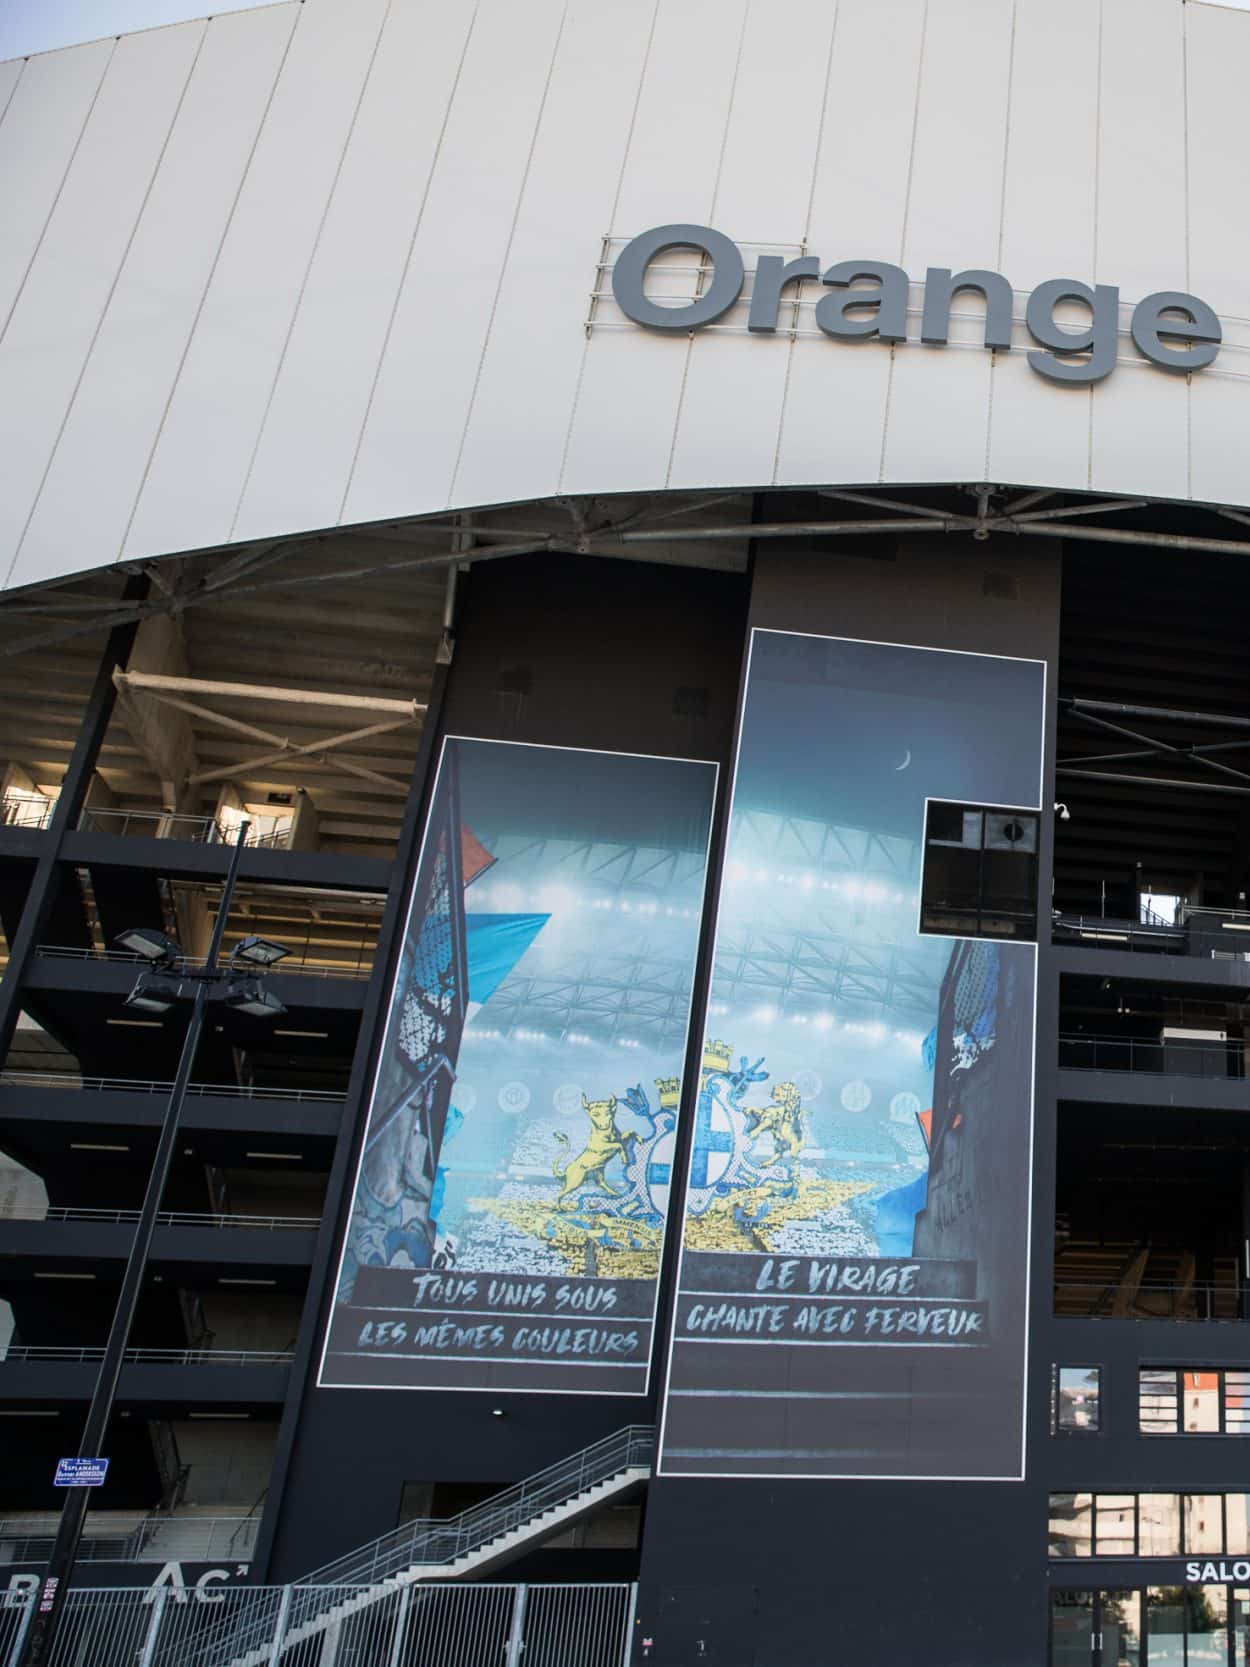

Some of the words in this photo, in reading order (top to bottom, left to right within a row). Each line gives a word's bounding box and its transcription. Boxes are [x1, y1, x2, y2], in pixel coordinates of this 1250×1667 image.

[612, 223, 1222, 385] Orange
[412, 1272, 478, 1306] TOUS
[487, 1279, 547, 1308] UNIS
[555, 1283, 618, 1311] SOUS
[755, 1259, 801, 1290] LE
[808, 1260, 921, 1294] VIRAGE
[358, 1319, 408, 1347] LES
[414, 1316, 505, 1348] MÊMES
[512, 1326, 640, 1356] COULEURS
[686, 1304, 790, 1332] CHANTE
[793, 1306, 857, 1334] AVEC
[864, 1307, 984, 1336] FERVEUR
